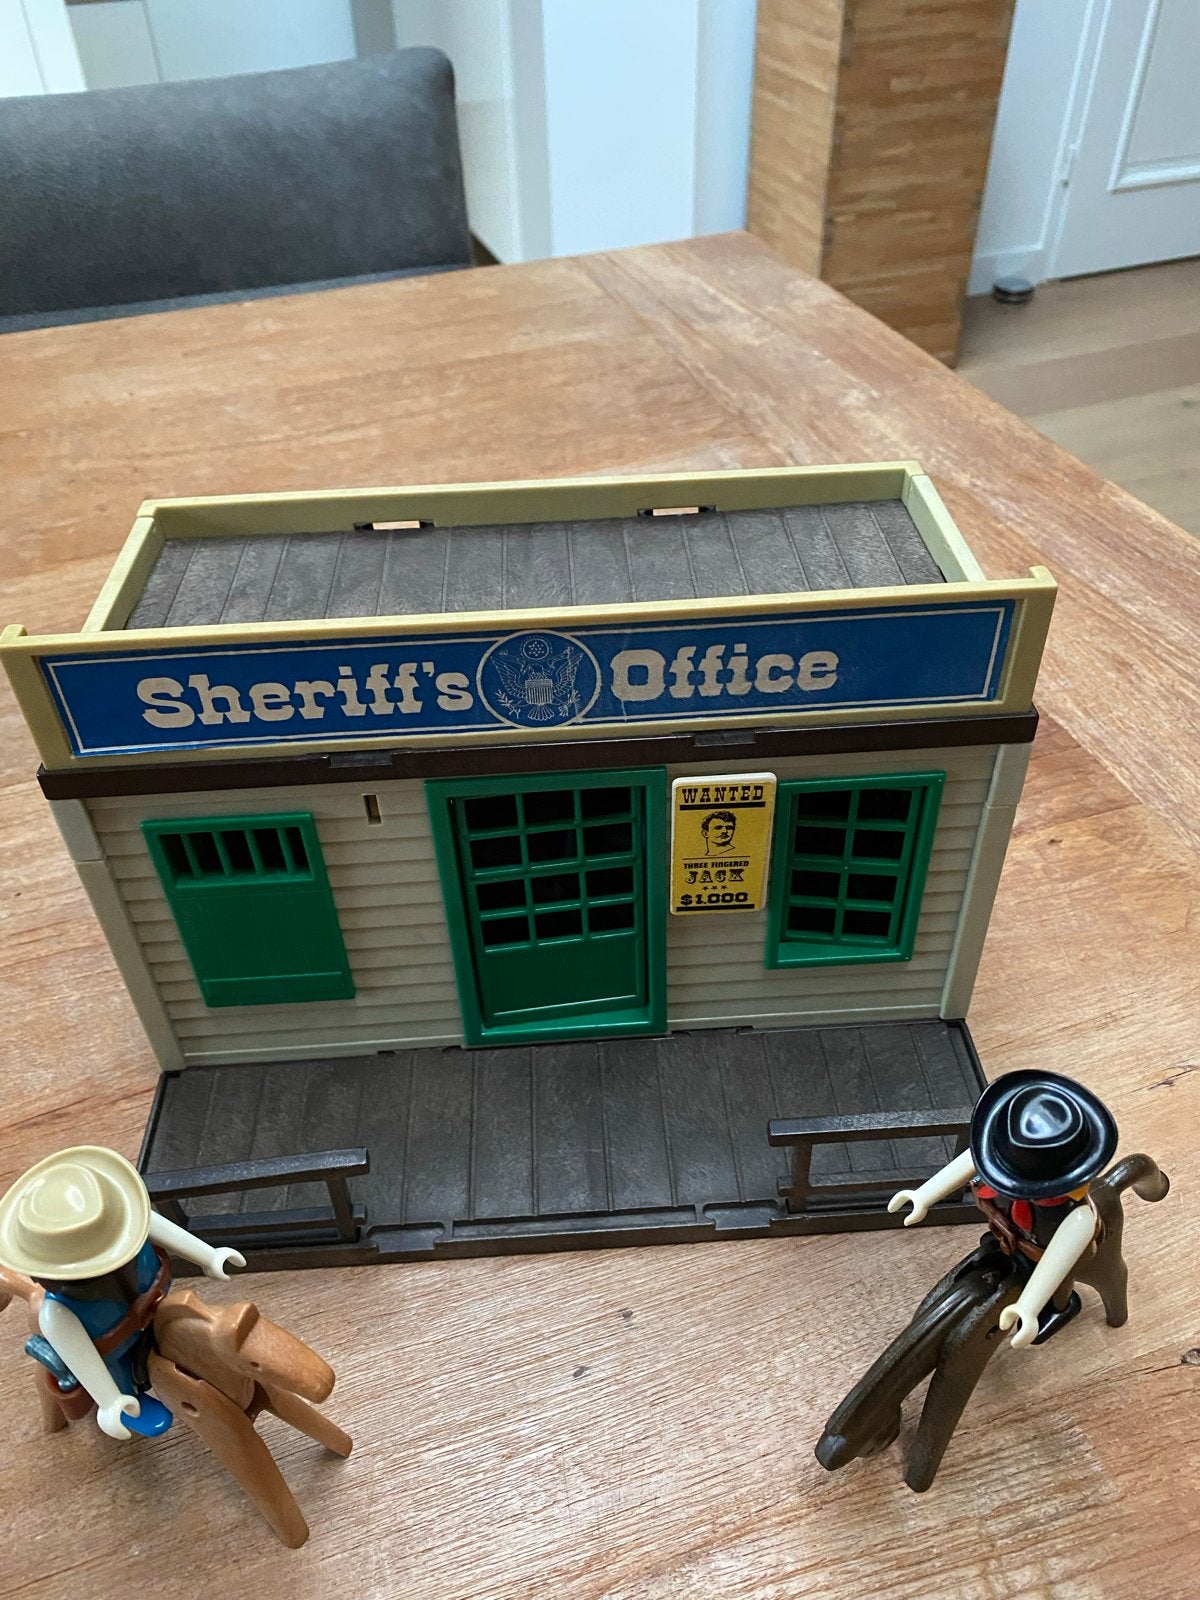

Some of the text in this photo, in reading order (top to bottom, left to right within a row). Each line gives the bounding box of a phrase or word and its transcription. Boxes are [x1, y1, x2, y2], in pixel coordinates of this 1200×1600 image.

[136, 643, 840, 729] Sheriff's Office
[681, 785, 764, 804] WANTED
[711, 860, 750, 868] FINGERED
[685, 869, 745, 884] JACK
